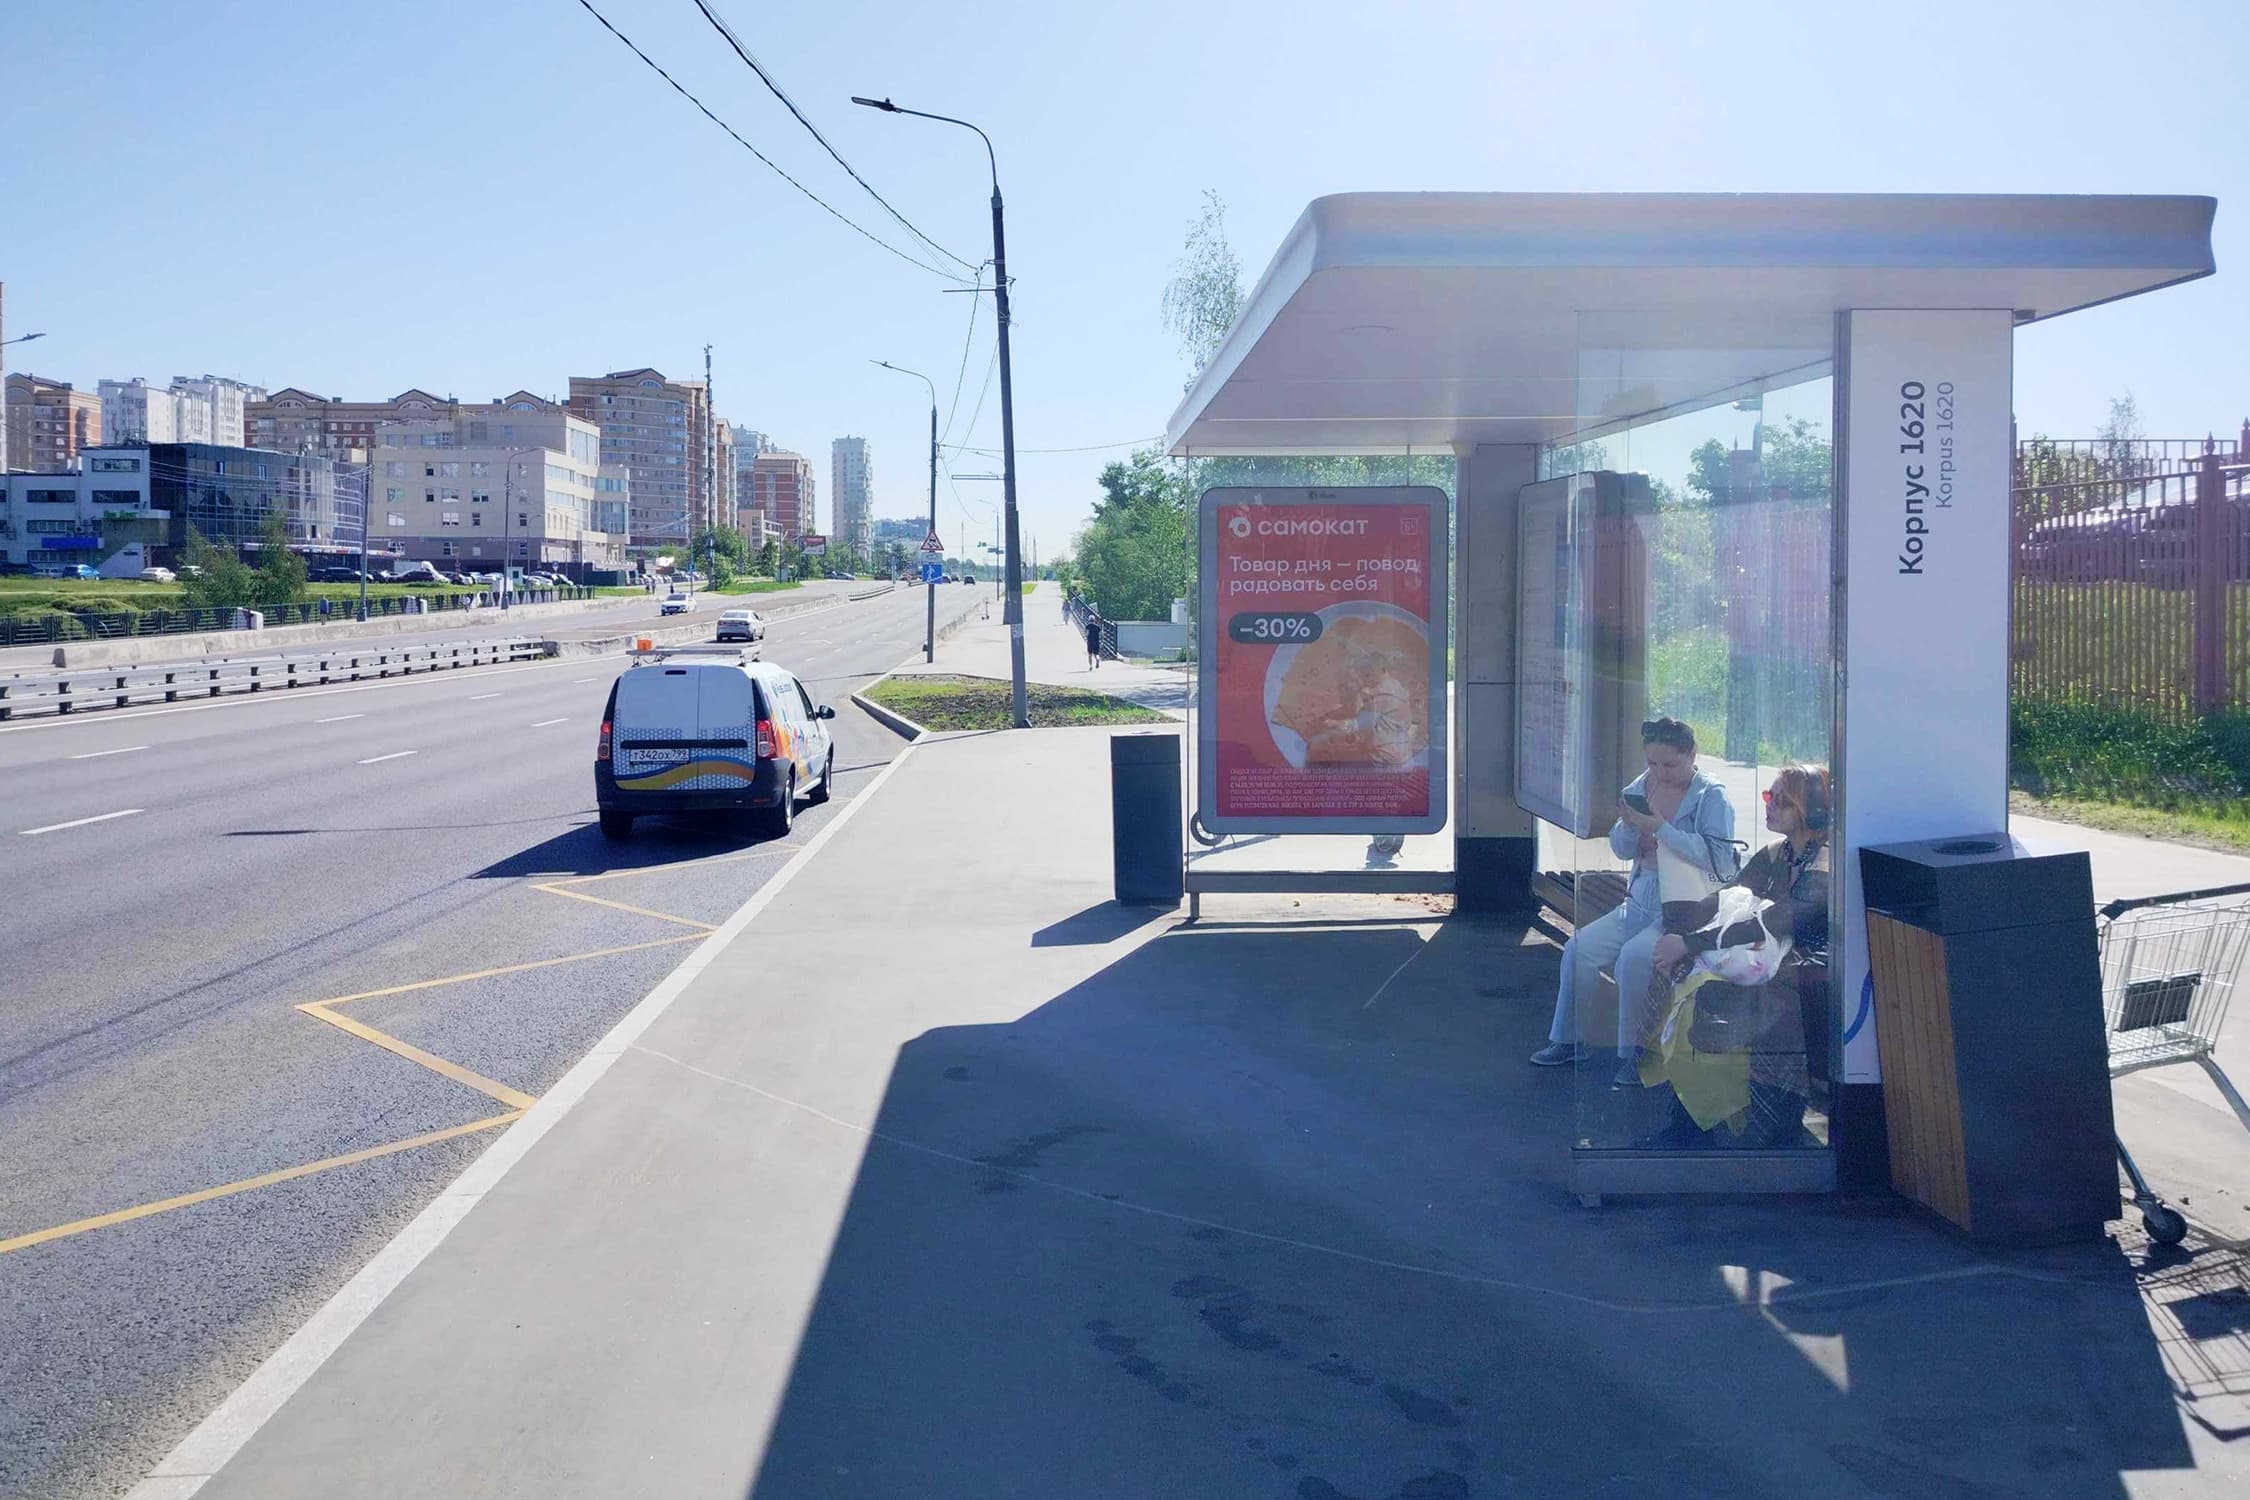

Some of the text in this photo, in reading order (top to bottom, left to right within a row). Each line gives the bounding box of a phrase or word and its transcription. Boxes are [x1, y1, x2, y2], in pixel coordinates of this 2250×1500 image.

[1935, 382, 1957, 508] Korpus 1620
[1899, 381, 1929, 574] Корпус 1620
[1257, 519, 1369, 536] самокат
[1230, 556, 1290, 576] Товар
[1295, 559, 1332, 574] дня
[1230, 575, 1378, 596] радовать себя
